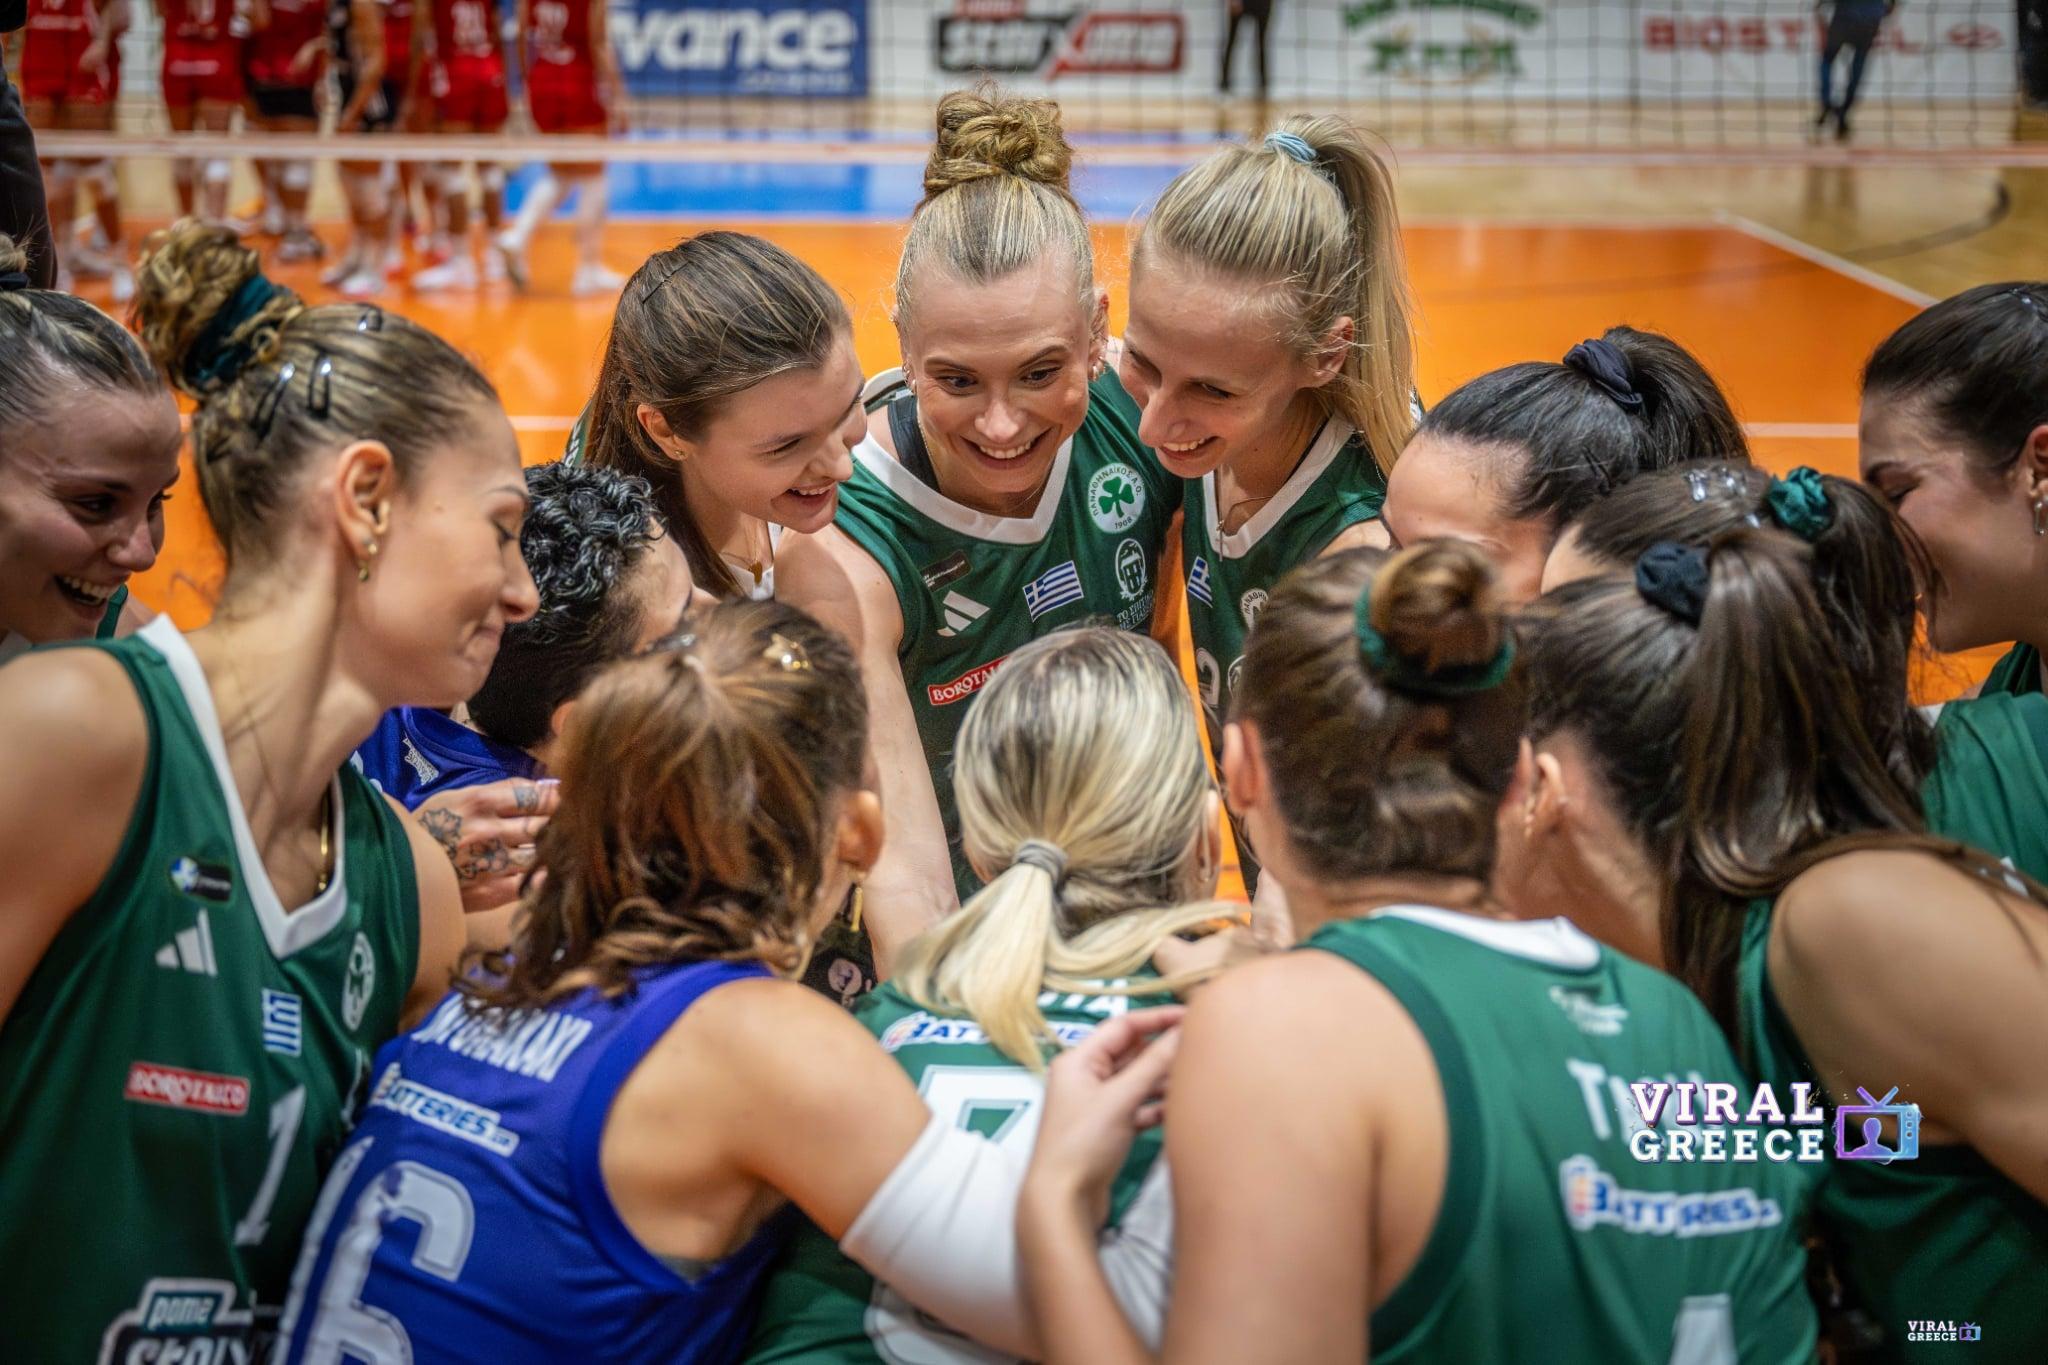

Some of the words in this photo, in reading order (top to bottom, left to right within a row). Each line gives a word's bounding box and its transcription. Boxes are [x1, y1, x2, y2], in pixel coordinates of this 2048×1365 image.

[609, 9, 859, 71] vance
[1644, 17, 1919, 53] BIOSTL
[1114, 516, 1133, 530] 1908
[932, 665, 1000, 702] BOROTA
